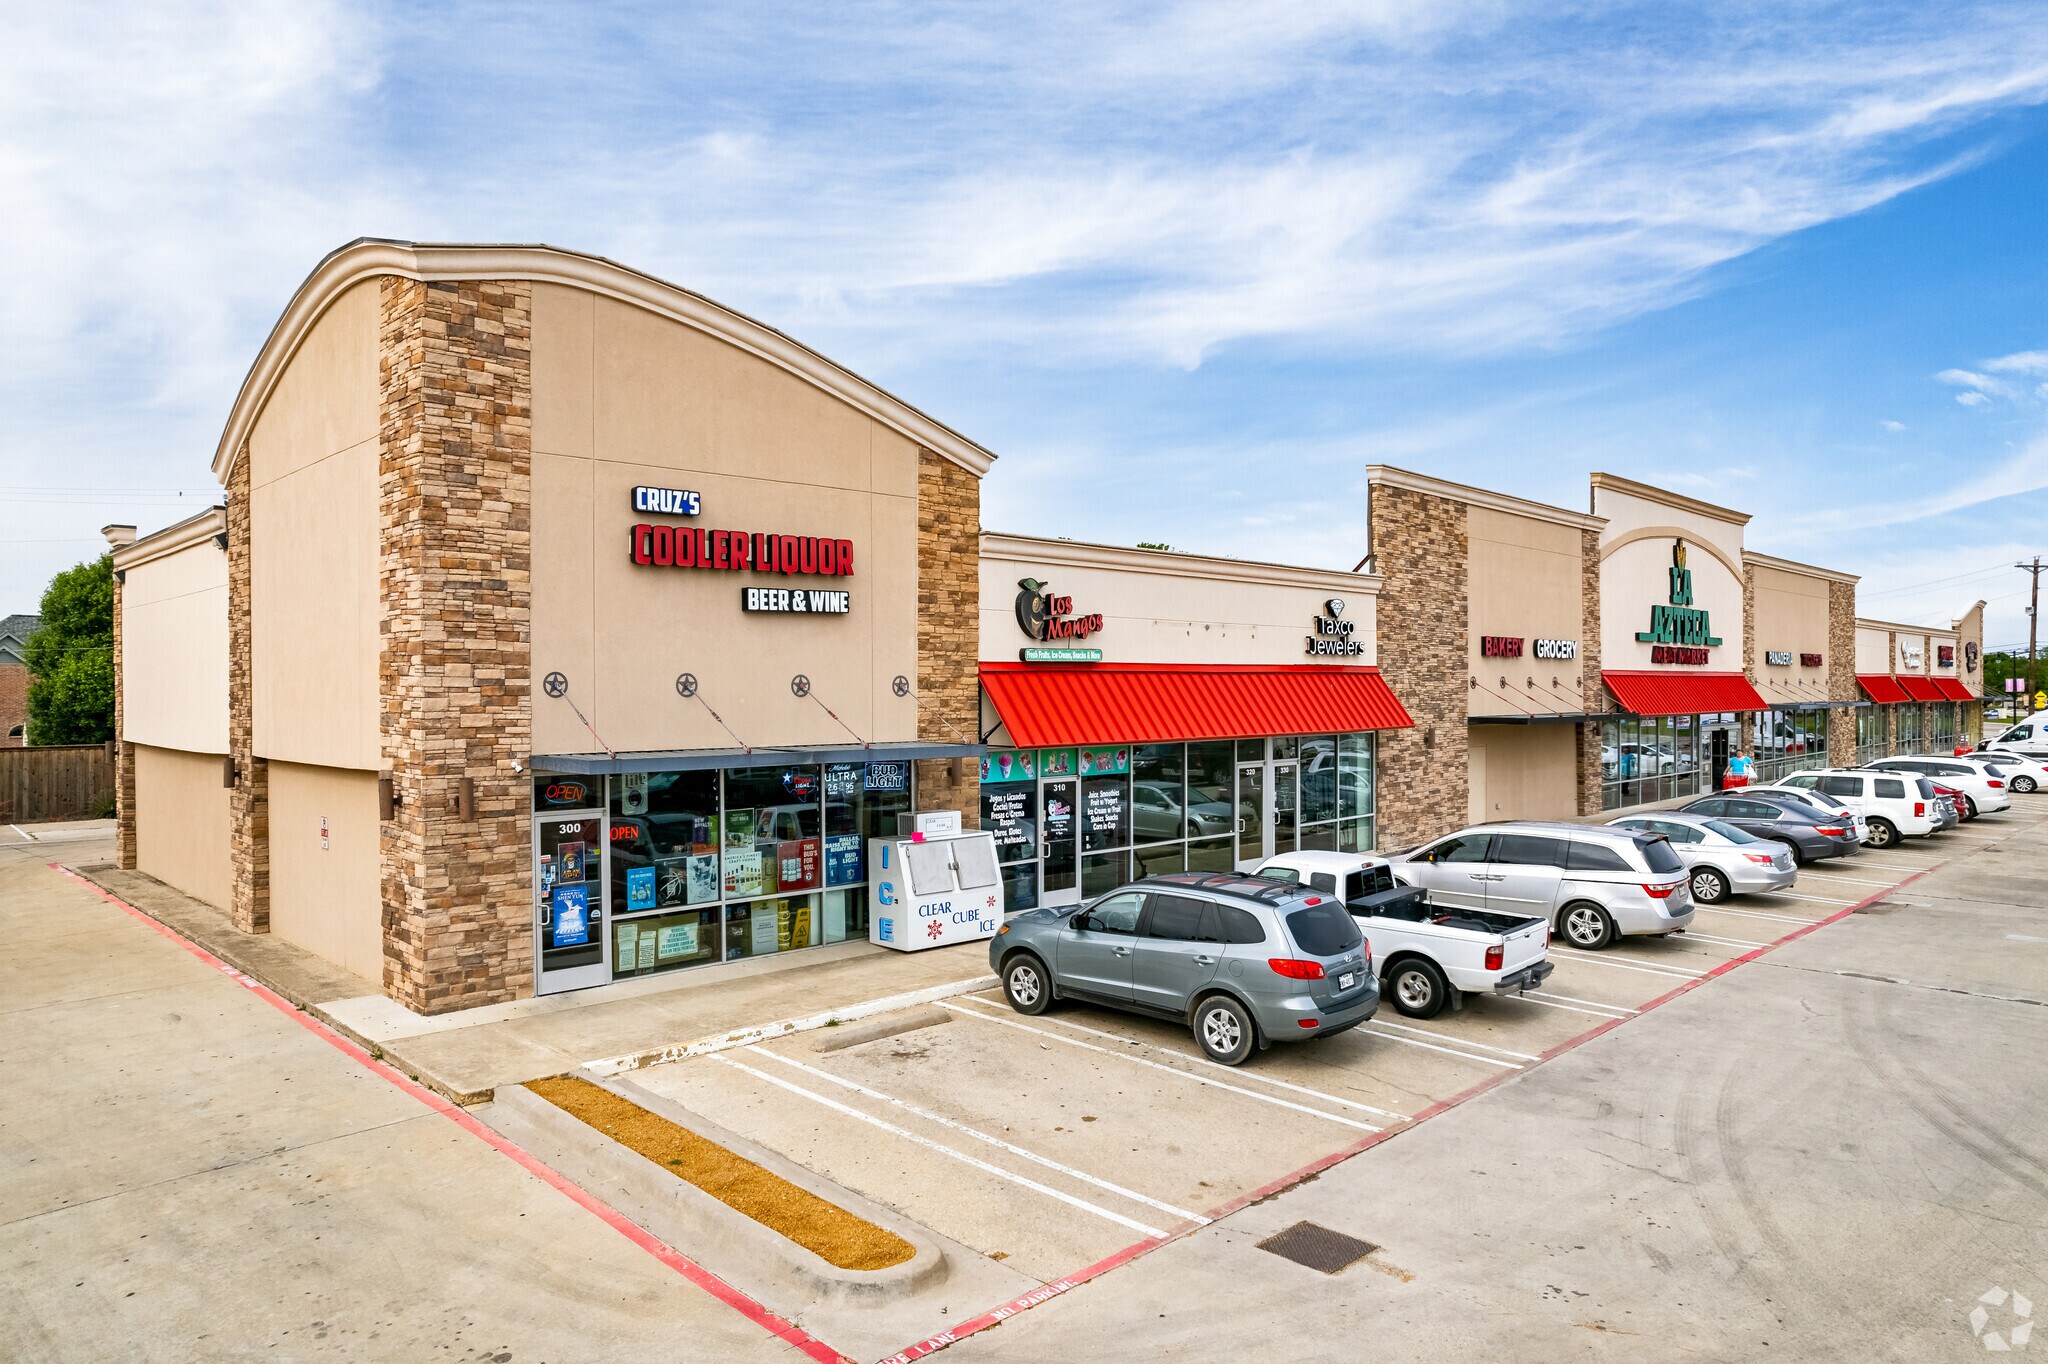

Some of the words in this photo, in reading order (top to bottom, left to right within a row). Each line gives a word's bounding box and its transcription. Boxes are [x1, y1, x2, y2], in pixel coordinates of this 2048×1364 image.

[636, 487, 700, 514] CRUZ'S
[635, 524, 749, 571] COOLER
[754, 532, 854, 576] LIQUOR
[1671, 567, 1693, 605] LA
[747, 588, 789, 611] BEER
[792, 590, 807, 611] &
[809, 590, 849, 613] WINE
[1050, 593, 1073, 616] Los
[1048, 613, 1103, 640] Mangos
[1319, 616, 1354, 635] Taxco
[1651, 605, 1713, 645] AZTECA
[1027, 650, 1038, 659] Fresh
[1073, 651, 1086, 659] Snacks
[1309, 636, 1365, 656] Jewelers
[1485, 636, 1524, 657] BAKERY
[1537, 639, 1577, 659] GROCERY
[1655, 646, 1677, 664] MEAT
[1678, 647, 1710, 665] MARKET
[824, 772, 857, 782] ULTRA
[872, 764, 898, 776] BUD
[866, 776, 902, 788] LIGHT
[546, 784, 584, 800] OPEN
[989, 795, 1002, 803] Jugos
[1007, 792, 1026, 801] Licuados
[1100, 789, 1120, 798] Smoothies
[559, 824, 581, 834] 300
[610, 826, 639, 840] OPEN
[878, 845, 894, 942] ICE
[919, 902, 951, 917] CLEAR
[952, 909, 980, 924] CUBE
[980, 919, 995, 932] ICE
[914, 1331, 959, 1354] LANE
[990, 1307, 1016, 1320] NO
[1016, 1280, 1079, 1309] PARKING
